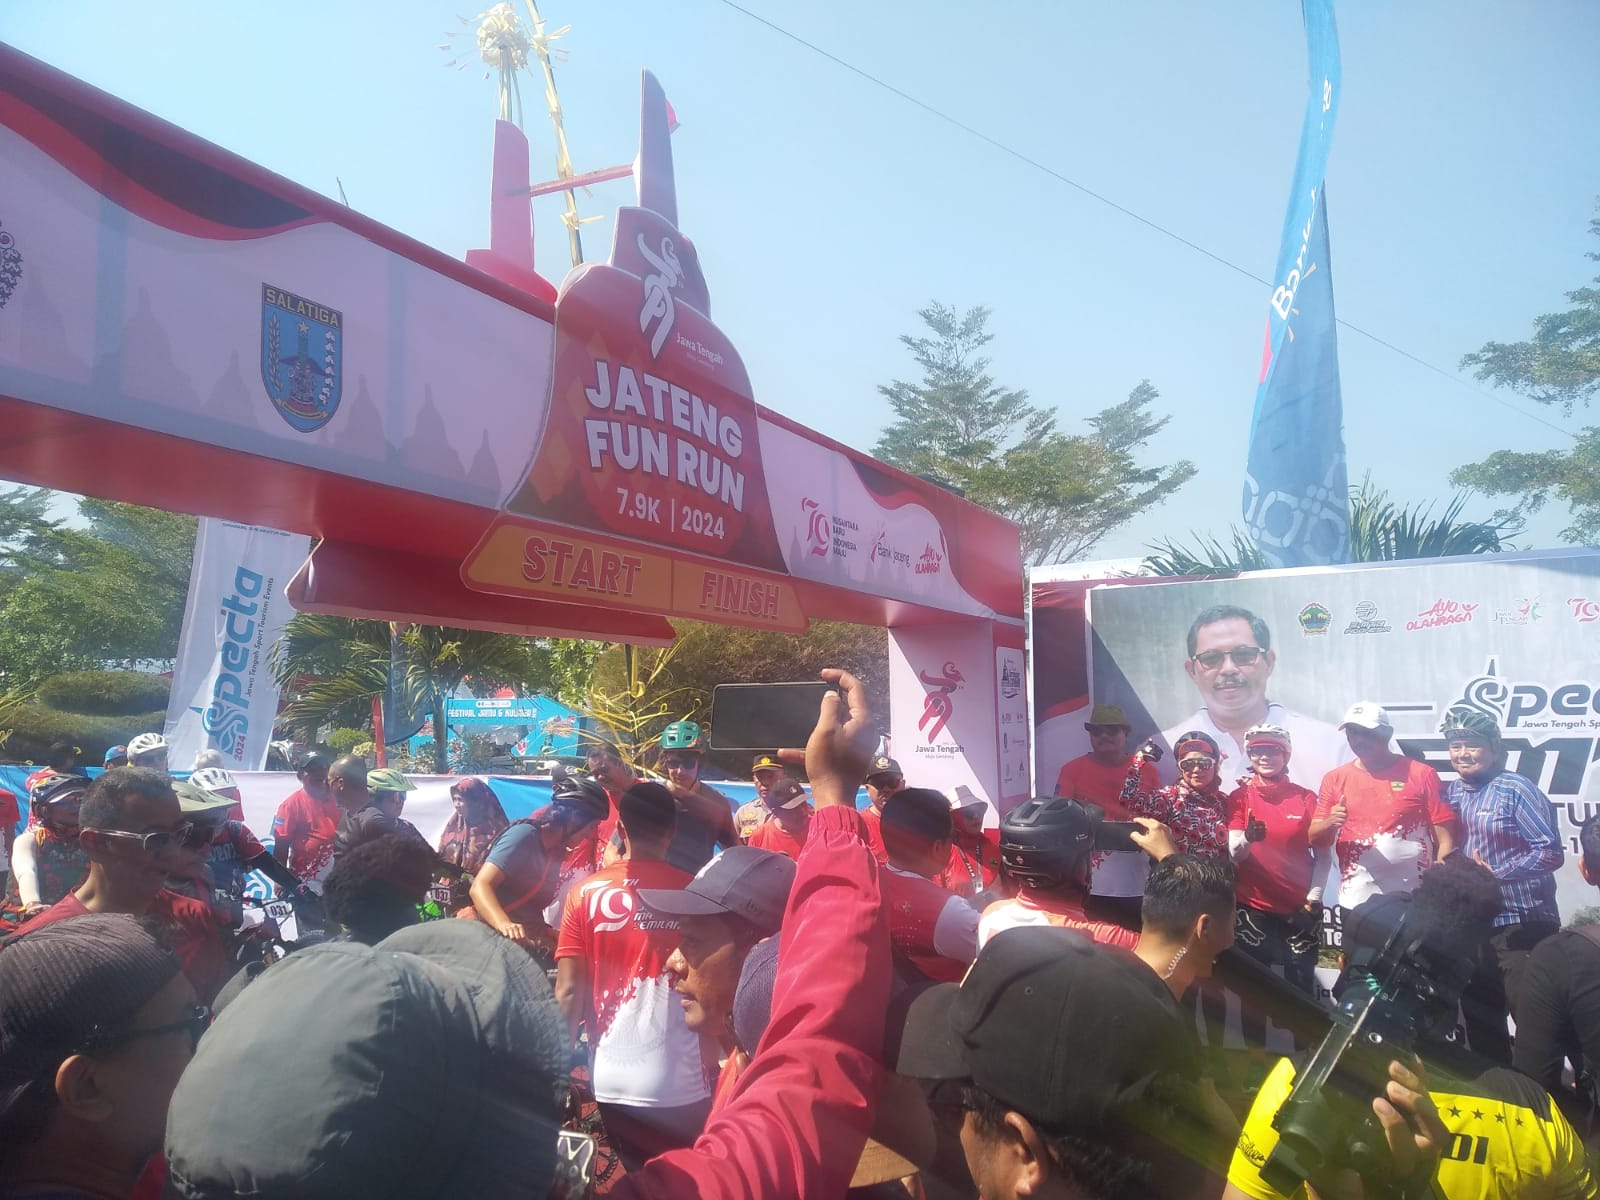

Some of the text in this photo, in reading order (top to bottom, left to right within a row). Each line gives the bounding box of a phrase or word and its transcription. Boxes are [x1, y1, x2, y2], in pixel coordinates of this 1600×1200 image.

[266, 288, 338, 327] SALATIGA
[695, 341, 723, 366] Tengah
[584, 360, 743, 459] JATENG
[585, 419, 745, 513] FUN RUN
[616, 487, 725, 540] 7.9K 2024
[522, 535, 642, 596] START
[701, 570, 780, 619] FINISH
[1406, 612, 1473, 631] OLAHRAGA
[448, 709, 475, 717] FESTIVAL
[1522, 720, 1549, 728] Jawa
[1550, 719, 1587, 730] Tengah
[234, 735, 247, 762] 2024
[915, 744, 965, 755] Jawa Tengah
[270, 905, 288, 916] 031
